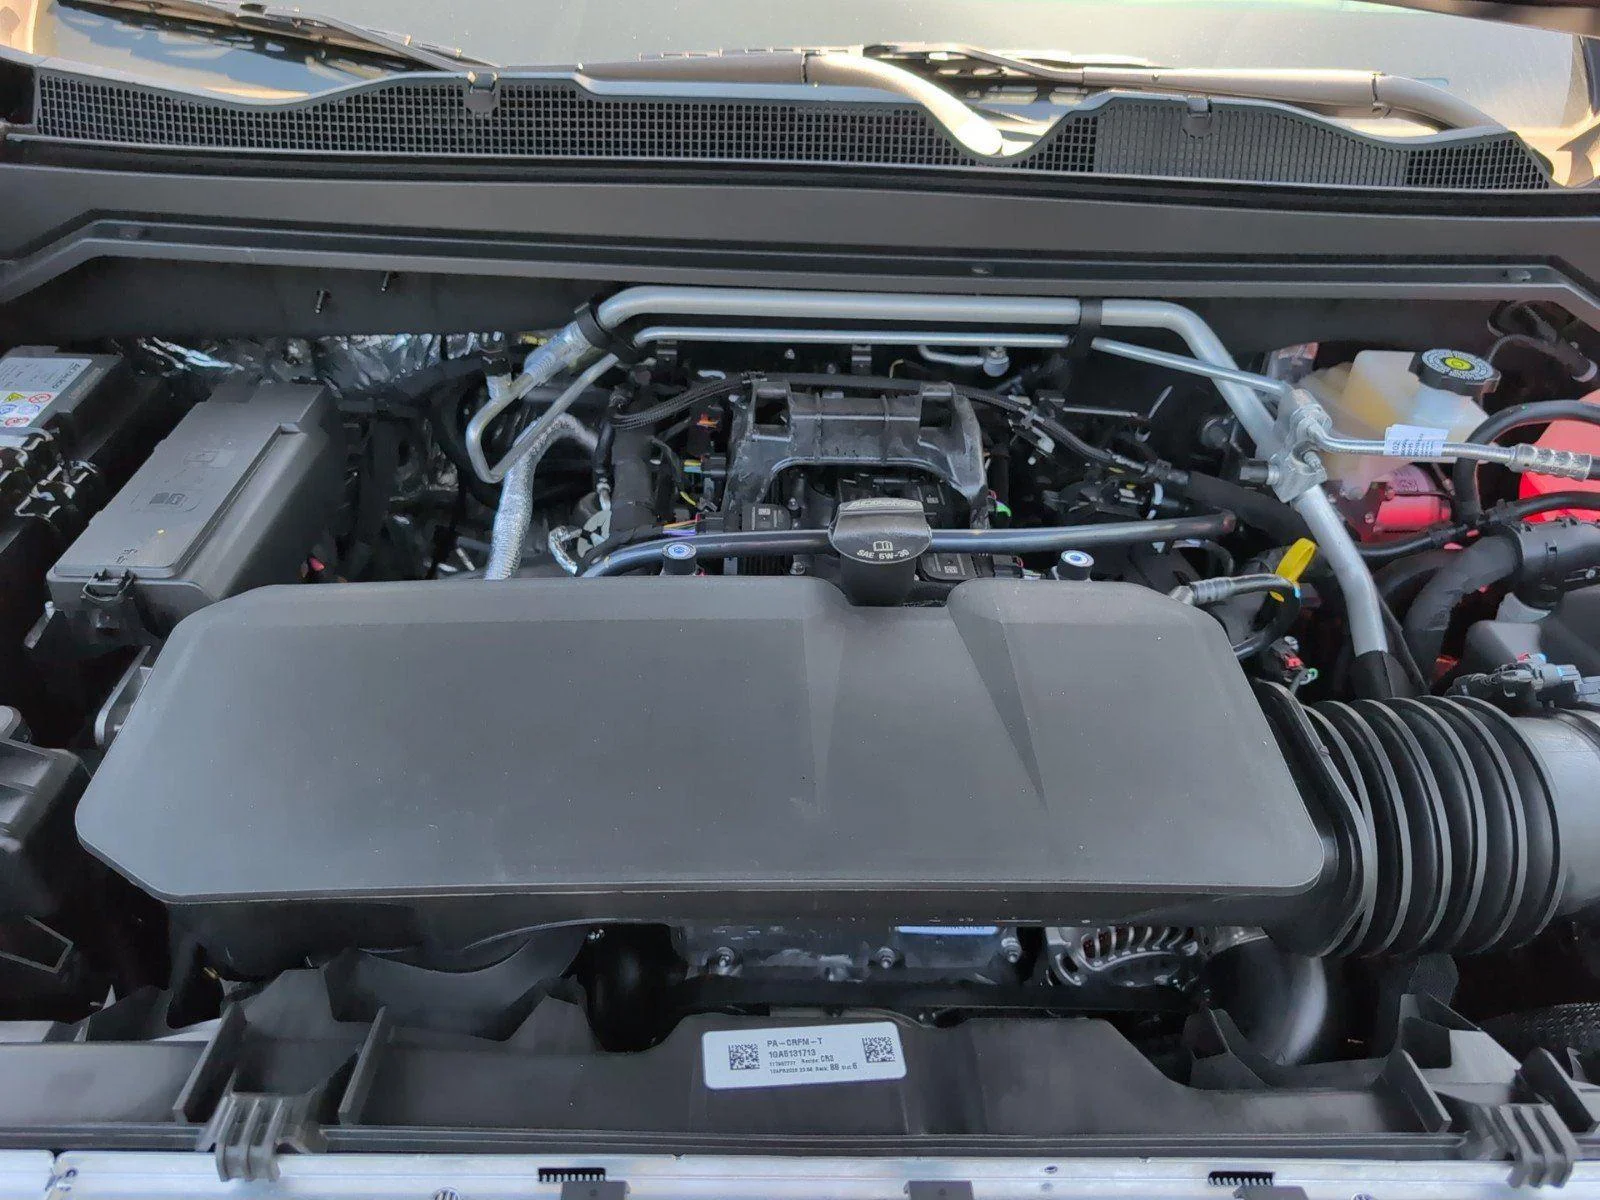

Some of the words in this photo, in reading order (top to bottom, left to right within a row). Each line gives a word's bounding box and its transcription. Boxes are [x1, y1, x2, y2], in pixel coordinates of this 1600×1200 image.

[857, 550, 875, 559] SAE
[879, 550, 910, 560] 5W-30
[767, 1037, 823, 1047] PA-CRFM-T
